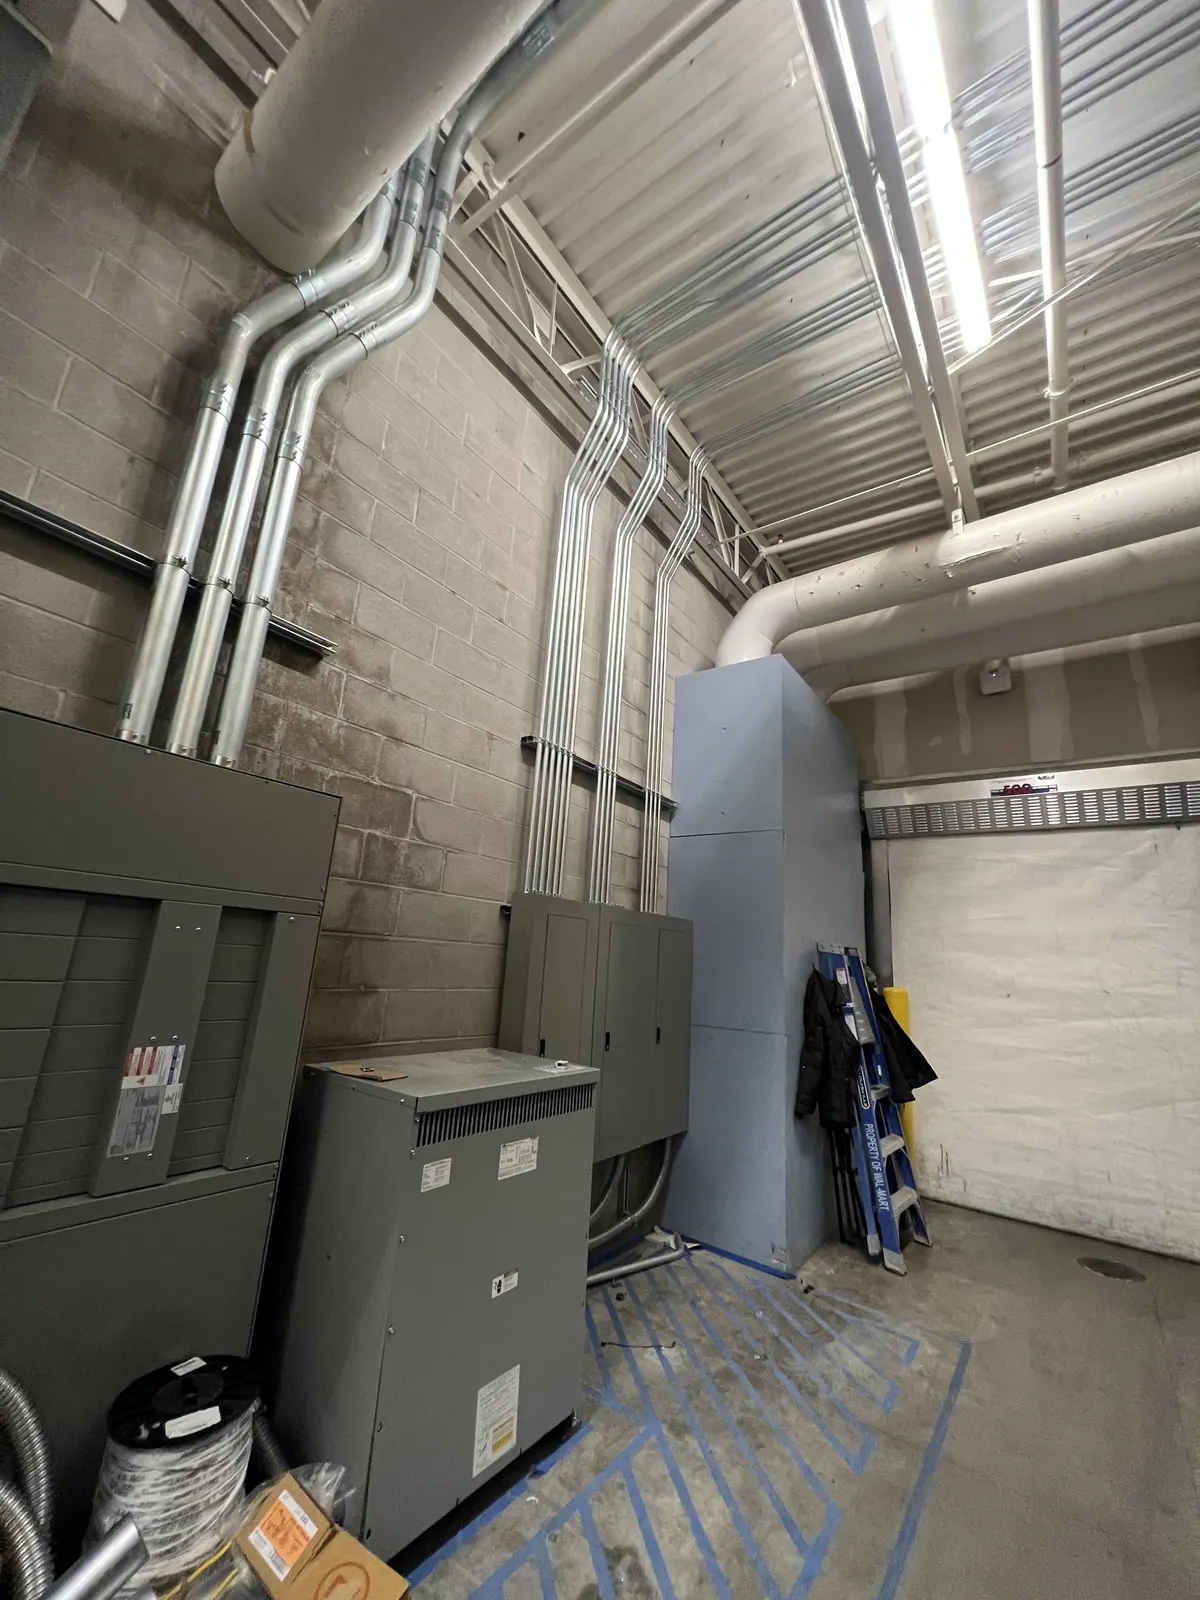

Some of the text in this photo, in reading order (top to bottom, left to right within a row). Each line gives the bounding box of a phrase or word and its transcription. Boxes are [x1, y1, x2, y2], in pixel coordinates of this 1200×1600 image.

[864, 1123, 890, 1211] PROPERTY OF WAL-MART
